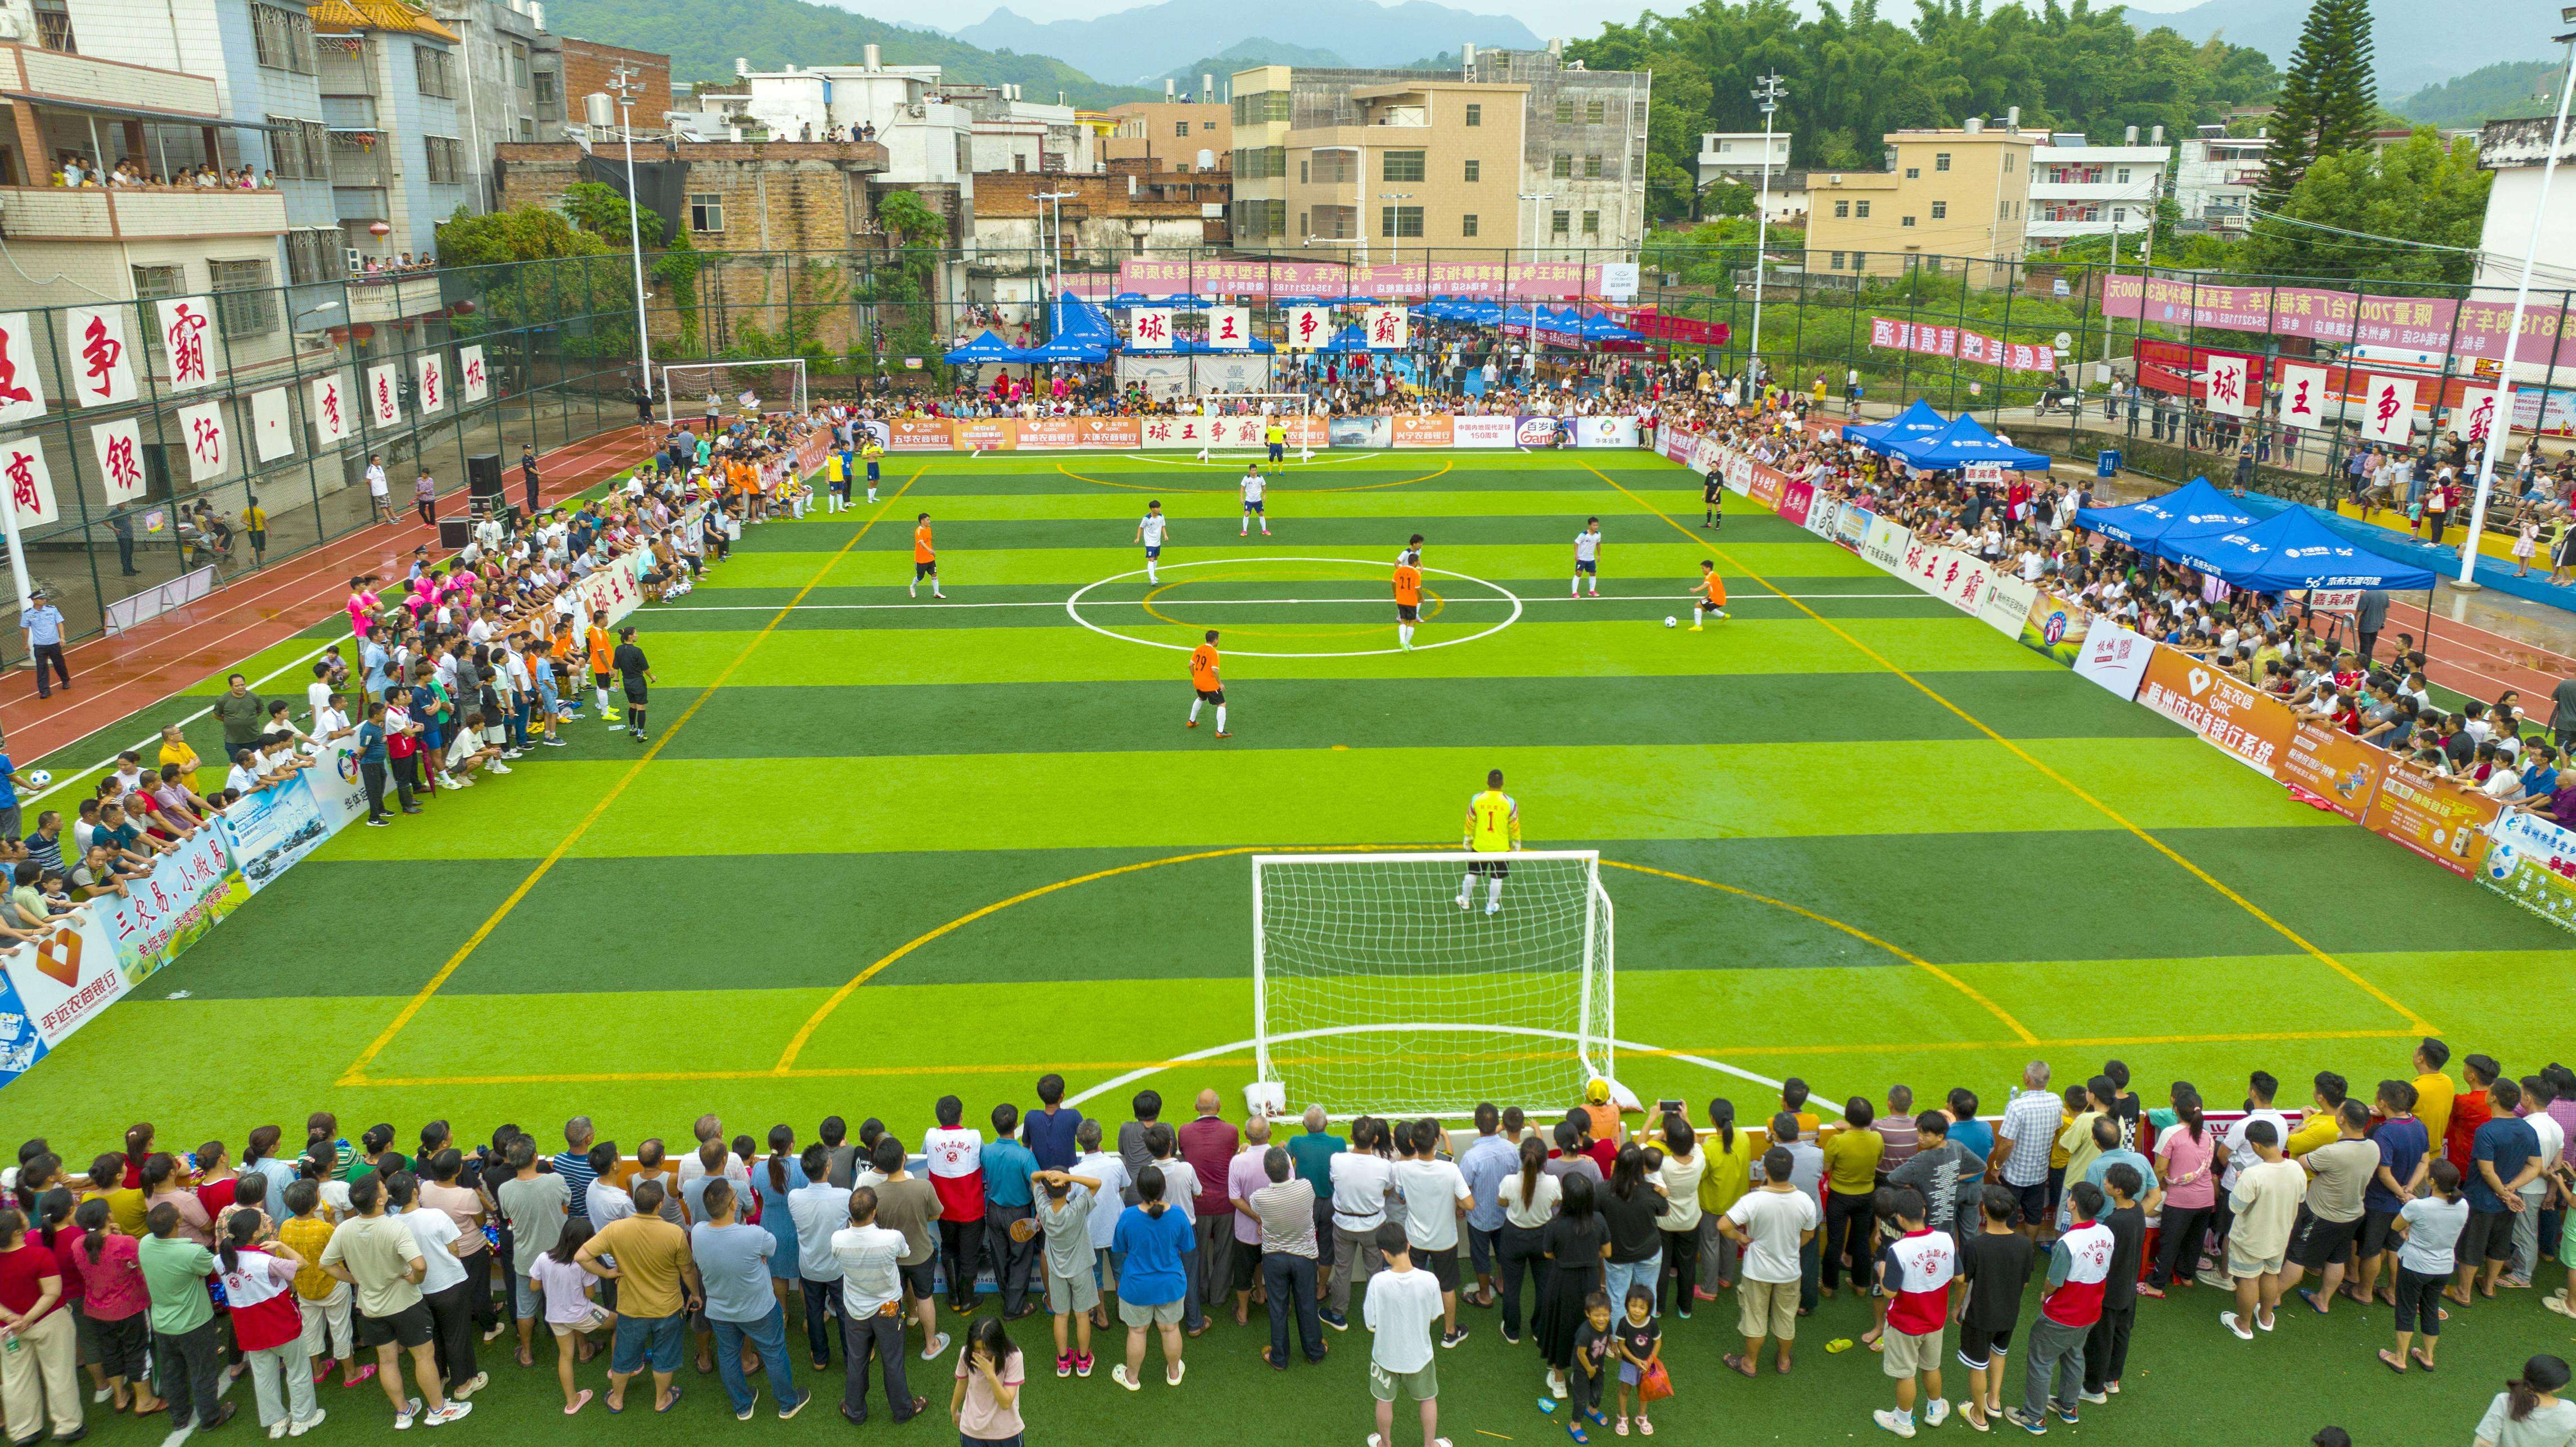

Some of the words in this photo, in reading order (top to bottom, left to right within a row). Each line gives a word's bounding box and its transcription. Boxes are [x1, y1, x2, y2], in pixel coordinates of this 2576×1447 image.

[894, 435, 949, 444] 五华农商银行
[1148, 421, 1260, 442] 球王争霸
[1396, 431, 1451, 440] 兴宁农商银行
[1967, 469, 1998, 480] 嘉宾席
[1906, 545, 1984, 605] 球王争霸
[2306, 575, 2325, 588] 5G
[2327, 576, 2383, 586] 未来无限可能
[2312, 591, 2356, 605] 嘉宾席
[1195, 654, 1207, 671] 29
[2213, 678, 2255, 711] 广东农信
[2398, 768, 2435, 790] 梅州农商银行
[2411, 792, 2452, 818] 焕新登场
[1487, 811, 1494, 832] 1
[41, 968, 117, 1032] 平远农商银行
[47, 1023, 71, 1039] PINGYUAN
[83, 997, 109, 1014] COMMERCIAL
[109, 985, 120, 997] BANK
[934, 1141, 972, 1154] 五华志愿者
[1911, 1249, 1948, 1268] 五华志愿者
[2083, 1239, 2112, 1259] 五华志愿者
